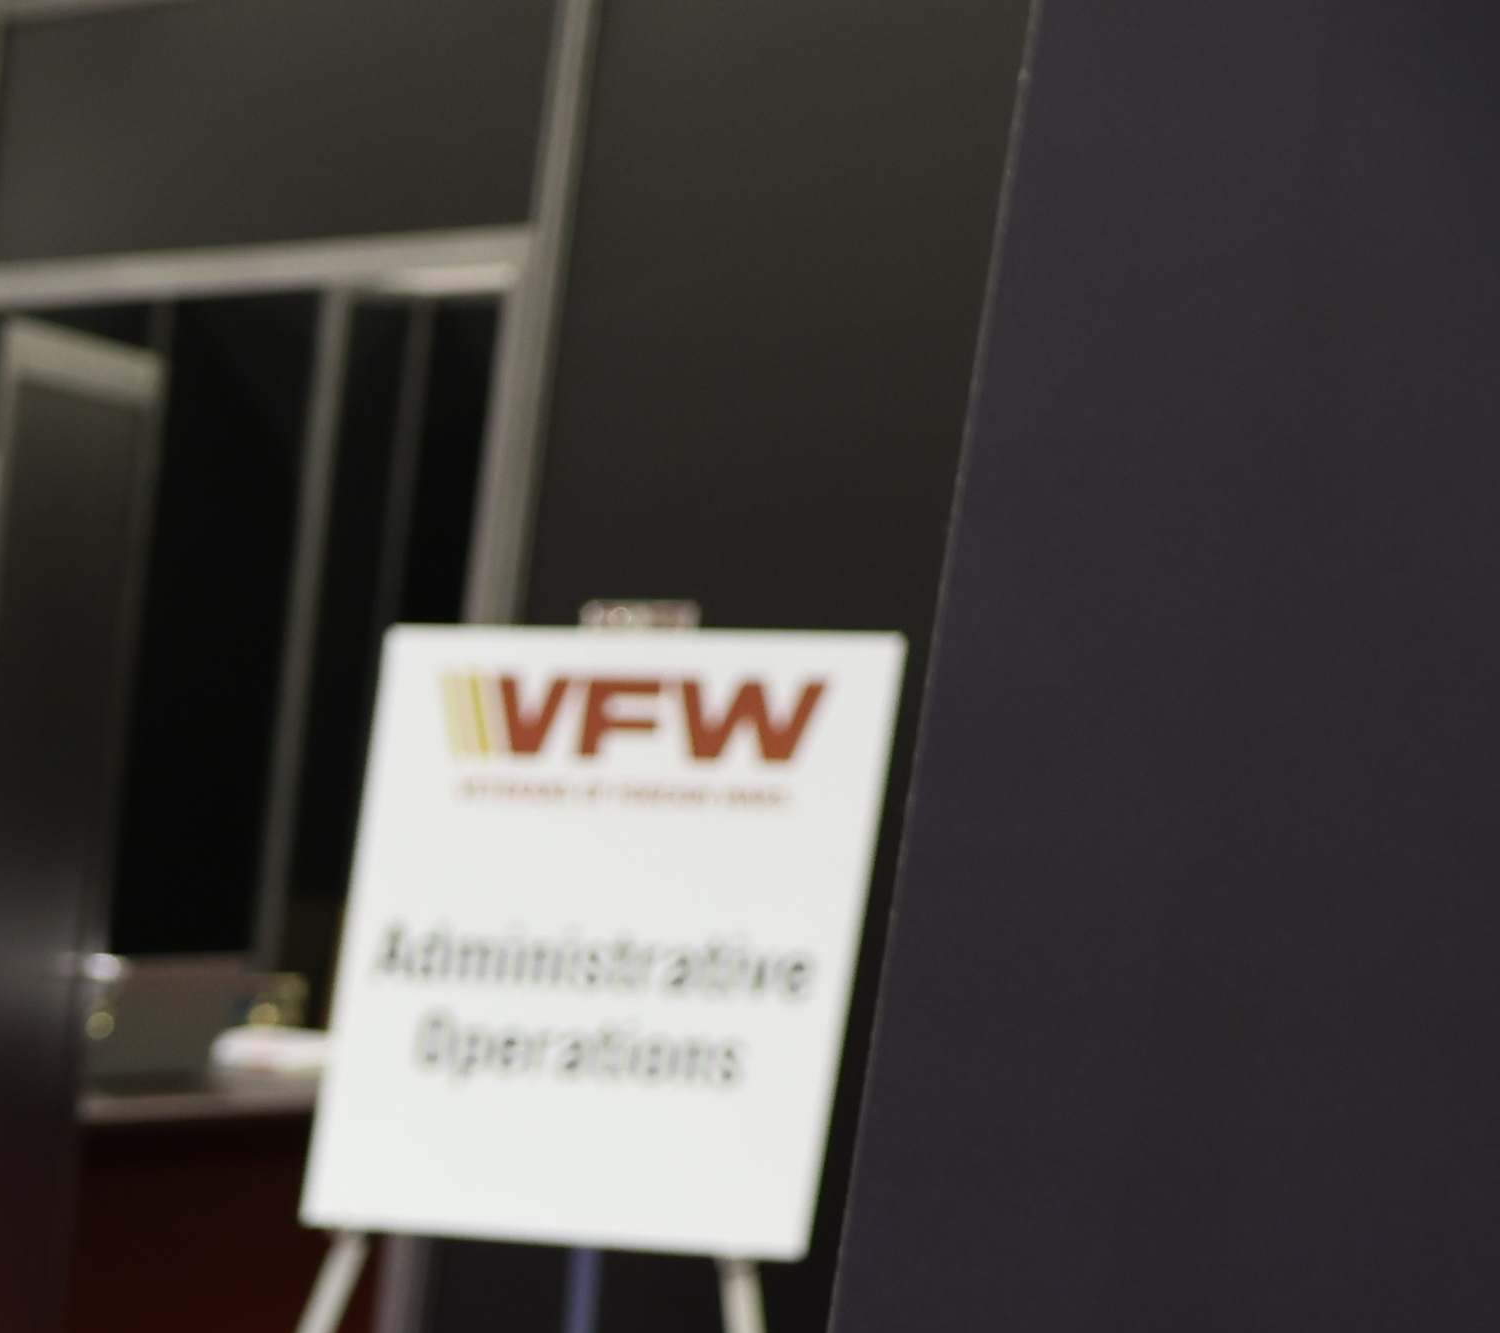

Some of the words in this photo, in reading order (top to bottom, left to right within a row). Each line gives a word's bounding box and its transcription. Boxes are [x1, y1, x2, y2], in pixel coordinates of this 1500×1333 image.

[498, 674, 829, 762] VFW
[376, 924, 813, 998] Administrative
[415, 1013, 740, 1084] Operations
